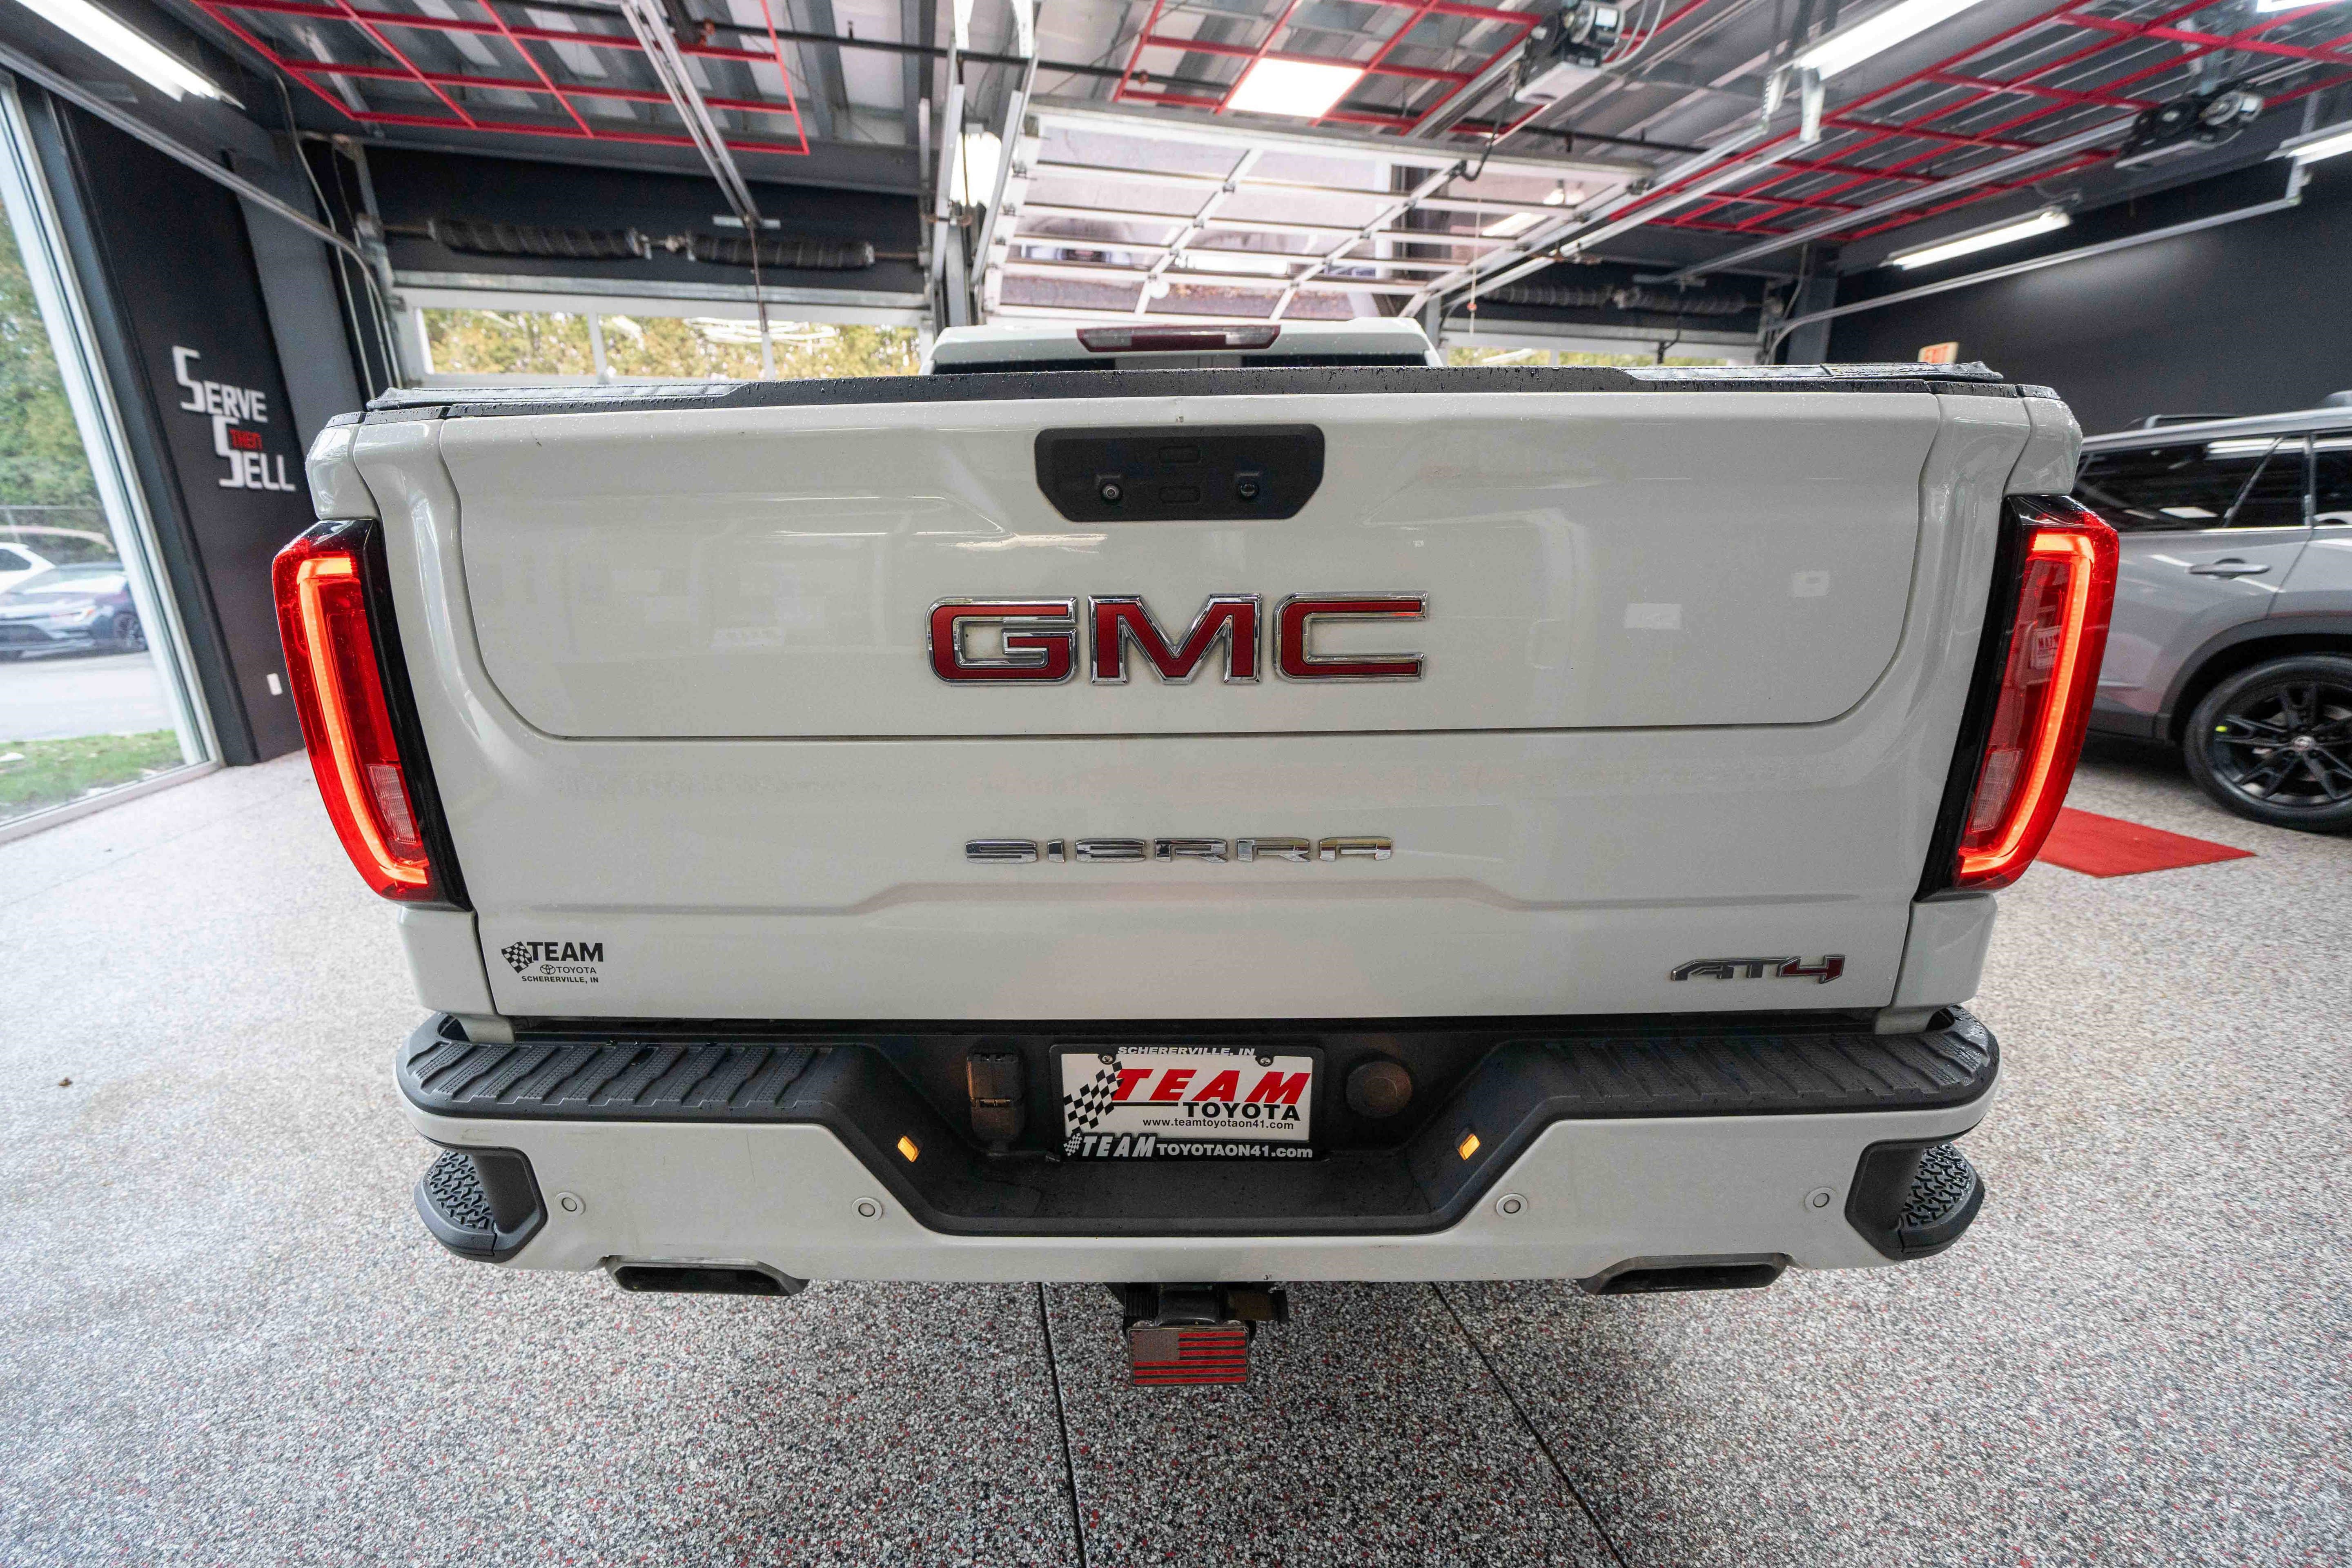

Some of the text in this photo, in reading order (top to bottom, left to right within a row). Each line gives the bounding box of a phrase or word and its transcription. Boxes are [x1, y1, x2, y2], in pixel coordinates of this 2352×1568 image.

[172, 345, 268, 423] SERVE
[212, 415, 296, 491] SELL
[926, 591, 1428, 686] GMC
[964, 837, 1393, 863] SIERRA
[527, 942, 604, 962] TEAM
[521, 976, 587, 984] SCHERERVILLE,
[1670, 954, 1846, 984] AT4
[1118, 1047, 1255, 1056] SCHERERVILLE, IN
[1111, 1068, 1311, 1105] TEAM
[1183, 1102, 1301, 1121] TOYOTA
[1143, 1118, 1294, 1130] www.teamtoyotaon41.com
[1082, 1136, 1156, 1157] TEAM
